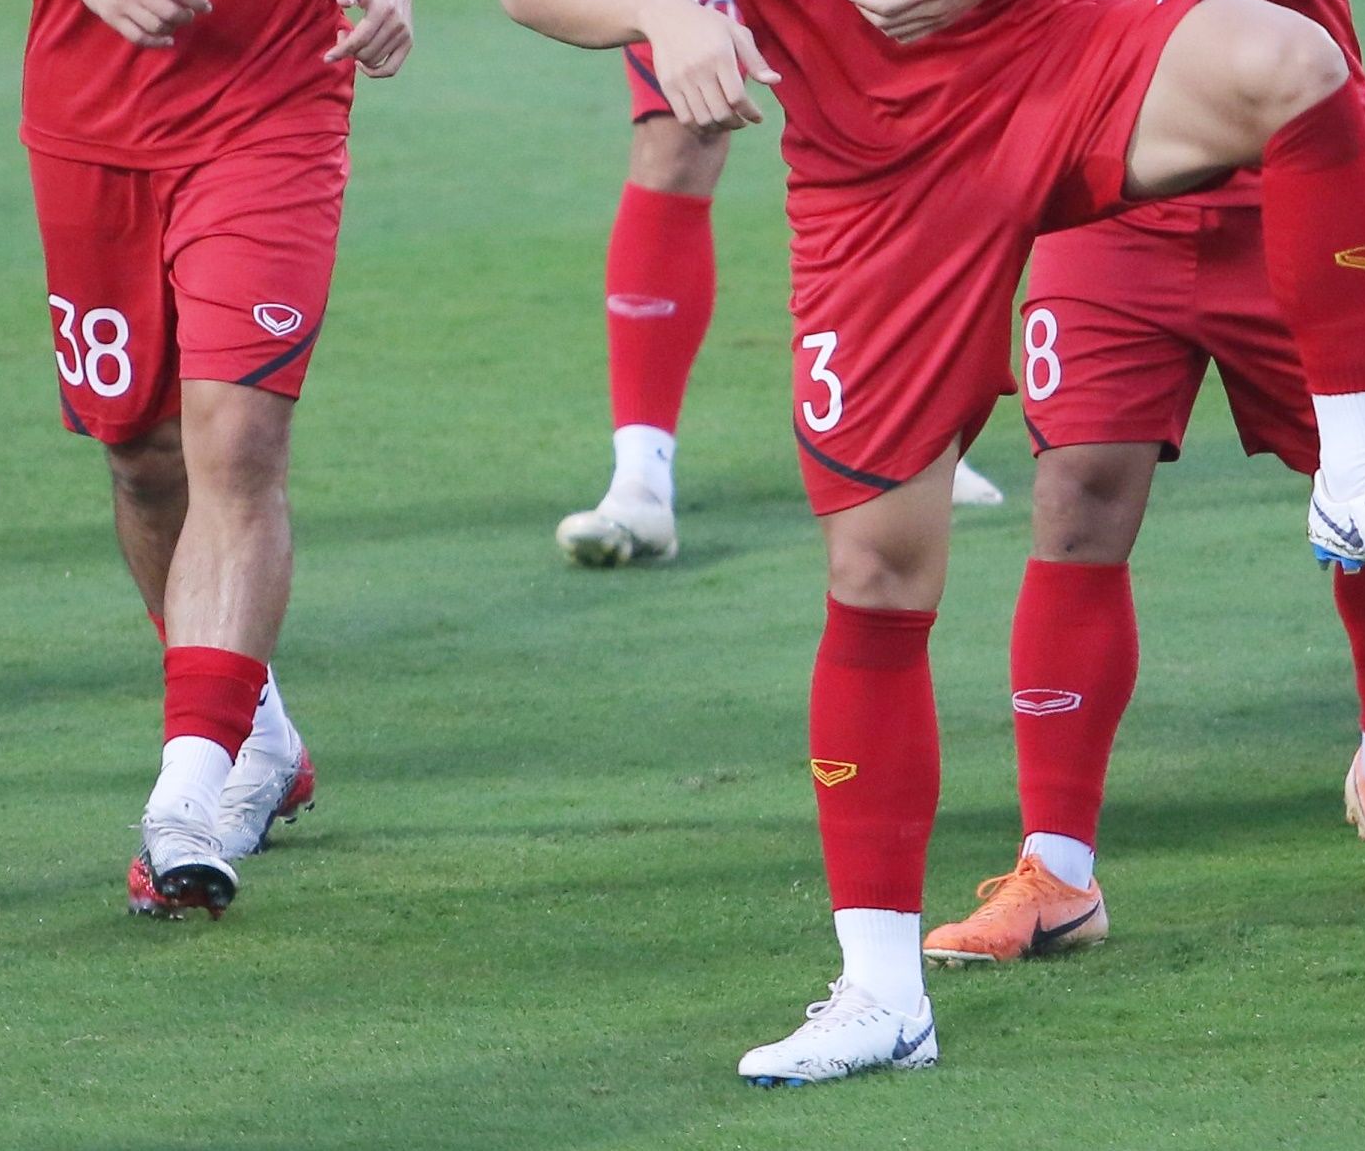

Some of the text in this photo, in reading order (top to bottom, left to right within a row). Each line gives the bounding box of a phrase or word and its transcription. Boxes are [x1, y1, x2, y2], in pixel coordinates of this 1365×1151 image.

[48, 293, 132, 398] 38
[802, 330, 843, 433] 3
[1024, 307, 1062, 401] 8
